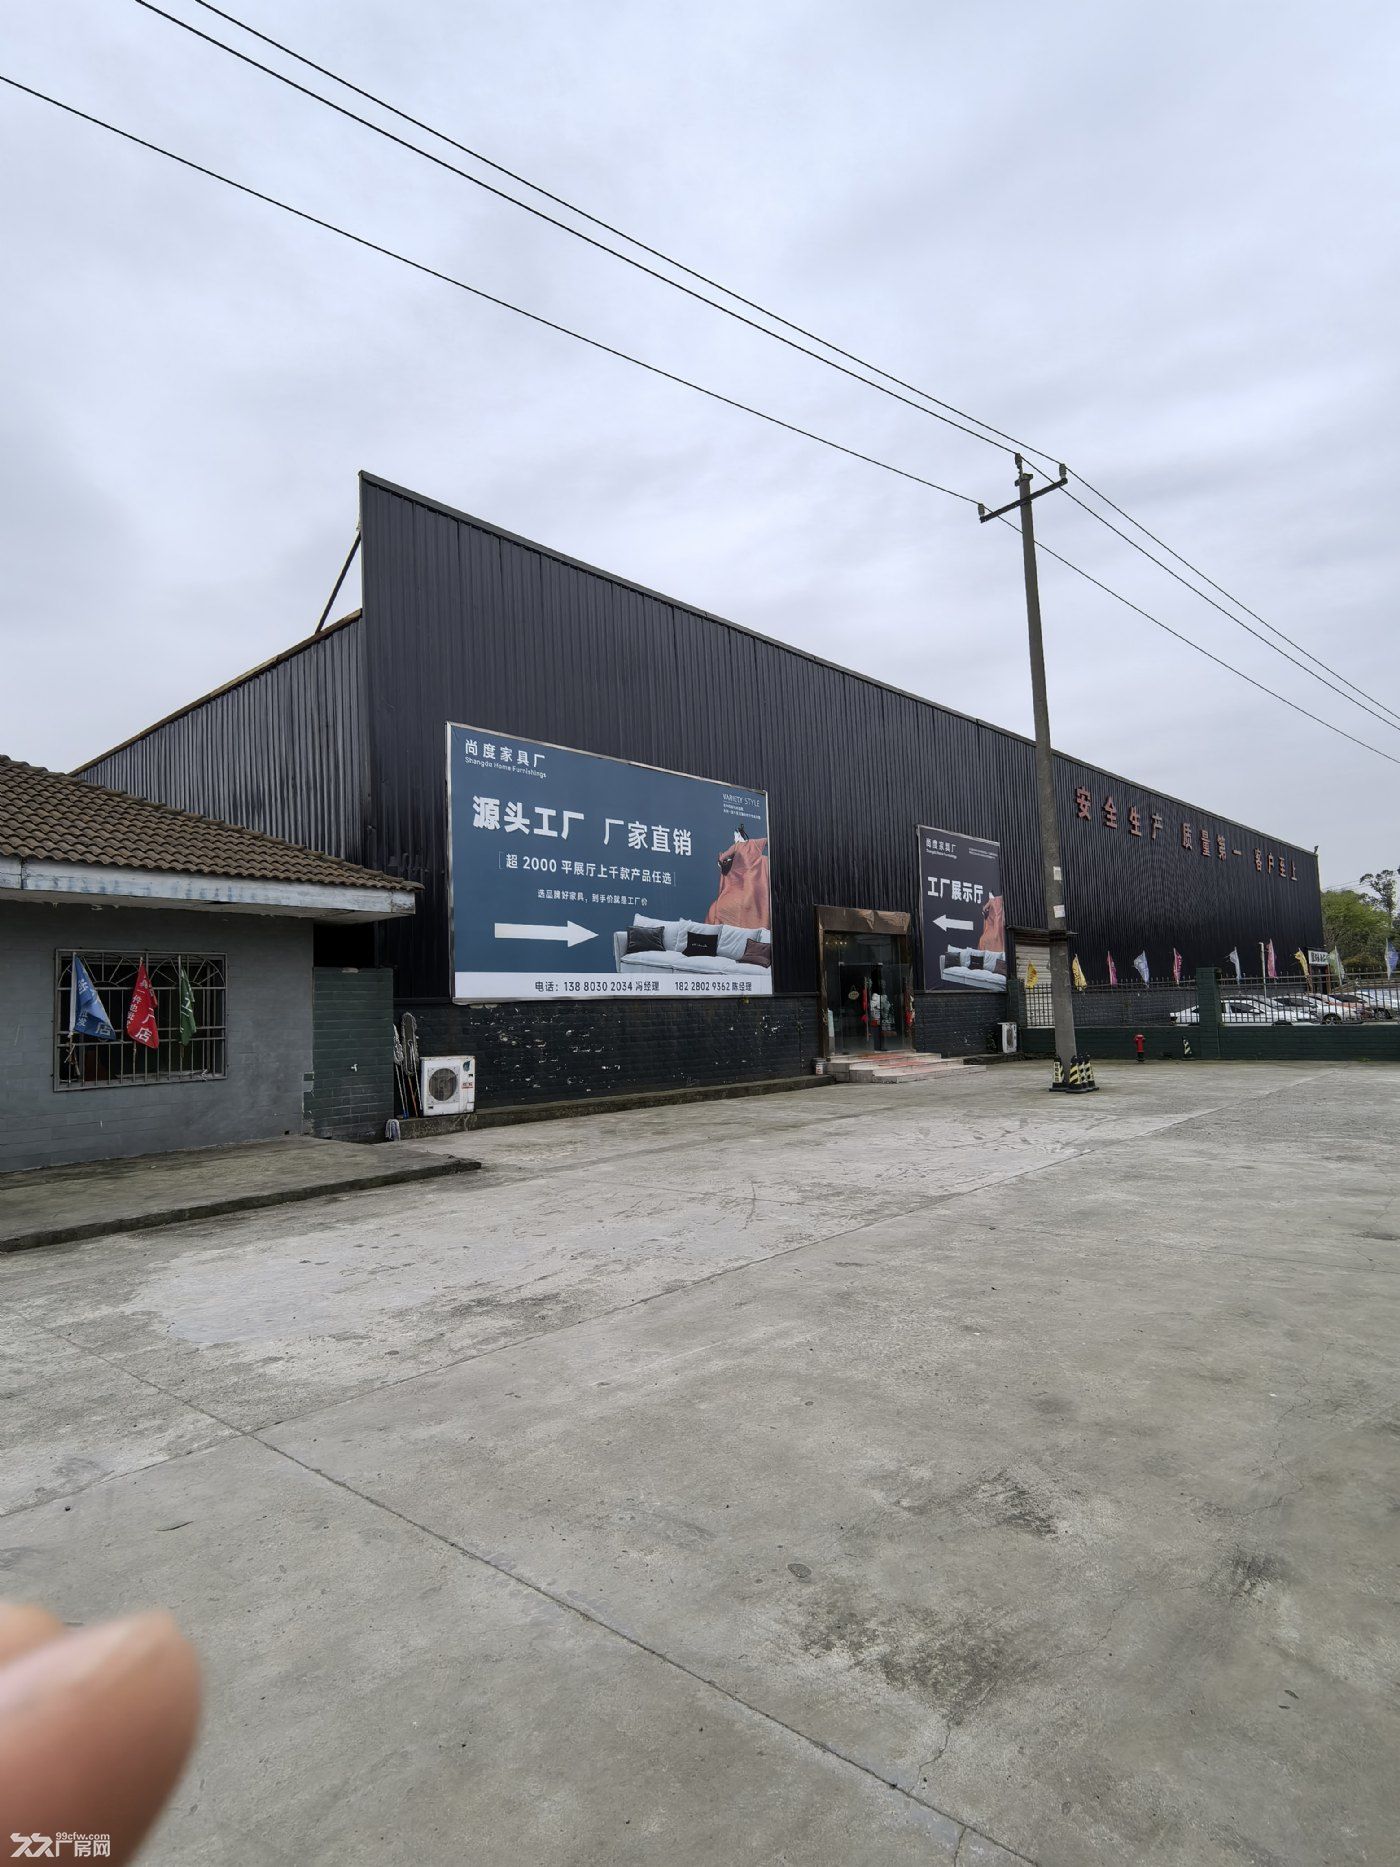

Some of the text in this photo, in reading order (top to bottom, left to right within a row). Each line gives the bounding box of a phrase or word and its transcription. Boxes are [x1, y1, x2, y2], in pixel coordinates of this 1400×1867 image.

[465, 739, 546, 767] 尚度家具厂
[472, 795, 692, 856] 源头工厂 厂家直销
[1075, 785, 1298, 881] 安全生产 质量第一 客户至上
[506, 853, 672, 885] 超 2000 平展厅上千款产品任选
[927, 876, 984, 904] 工厂展示厅
[563, 981, 581, 992] 138
[583, 981, 608, 992] 8030
[610, 981, 633, 992] 2034
[635, 981, 660, 992] 冯经理
[675, 981, 689, 991] 182
[691, 981, 710, 991] 2802
[712, 981, 730, 991] 9362
